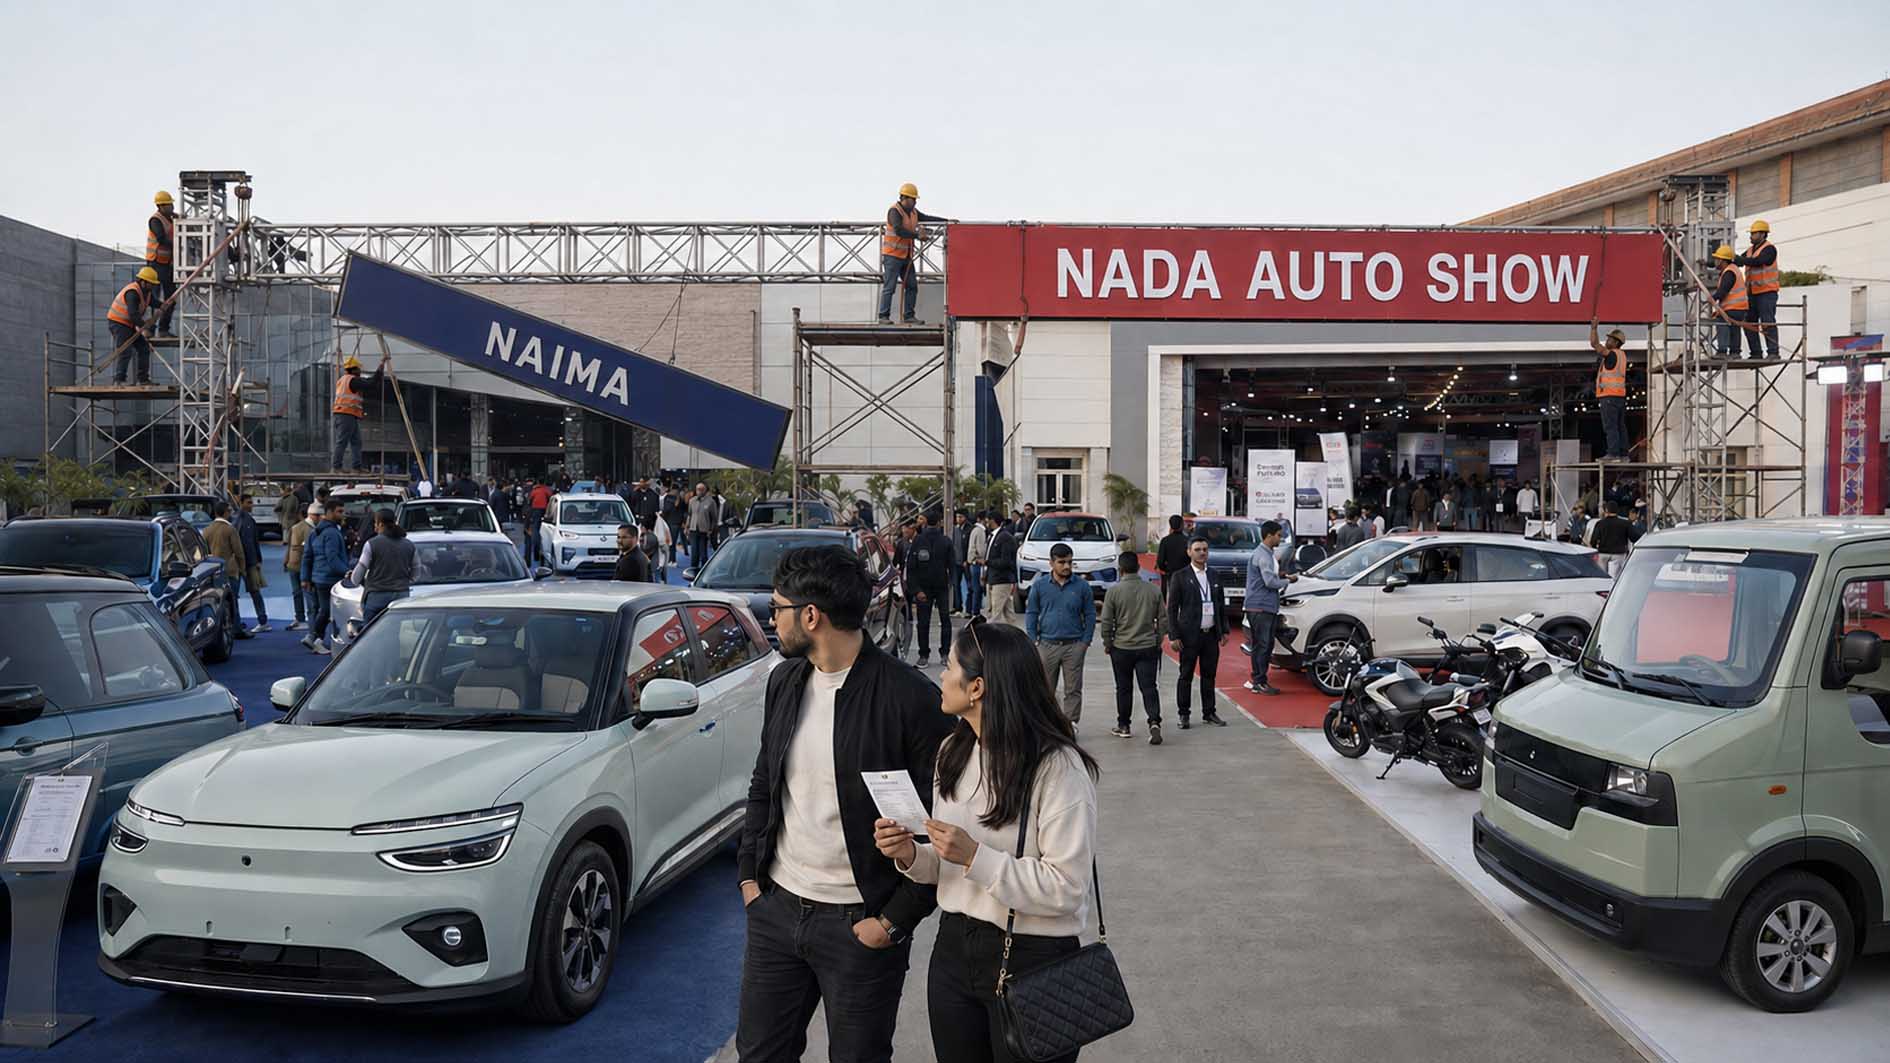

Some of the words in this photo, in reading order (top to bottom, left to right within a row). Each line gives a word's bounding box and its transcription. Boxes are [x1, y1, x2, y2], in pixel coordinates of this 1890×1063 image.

[1056, 247, 1223, 300] NADA
[1246, 250, 1404, 302] AUTO
[1426, 252, 1590, 304] SHOW
[484, 321, 629, 406] NAIMA
